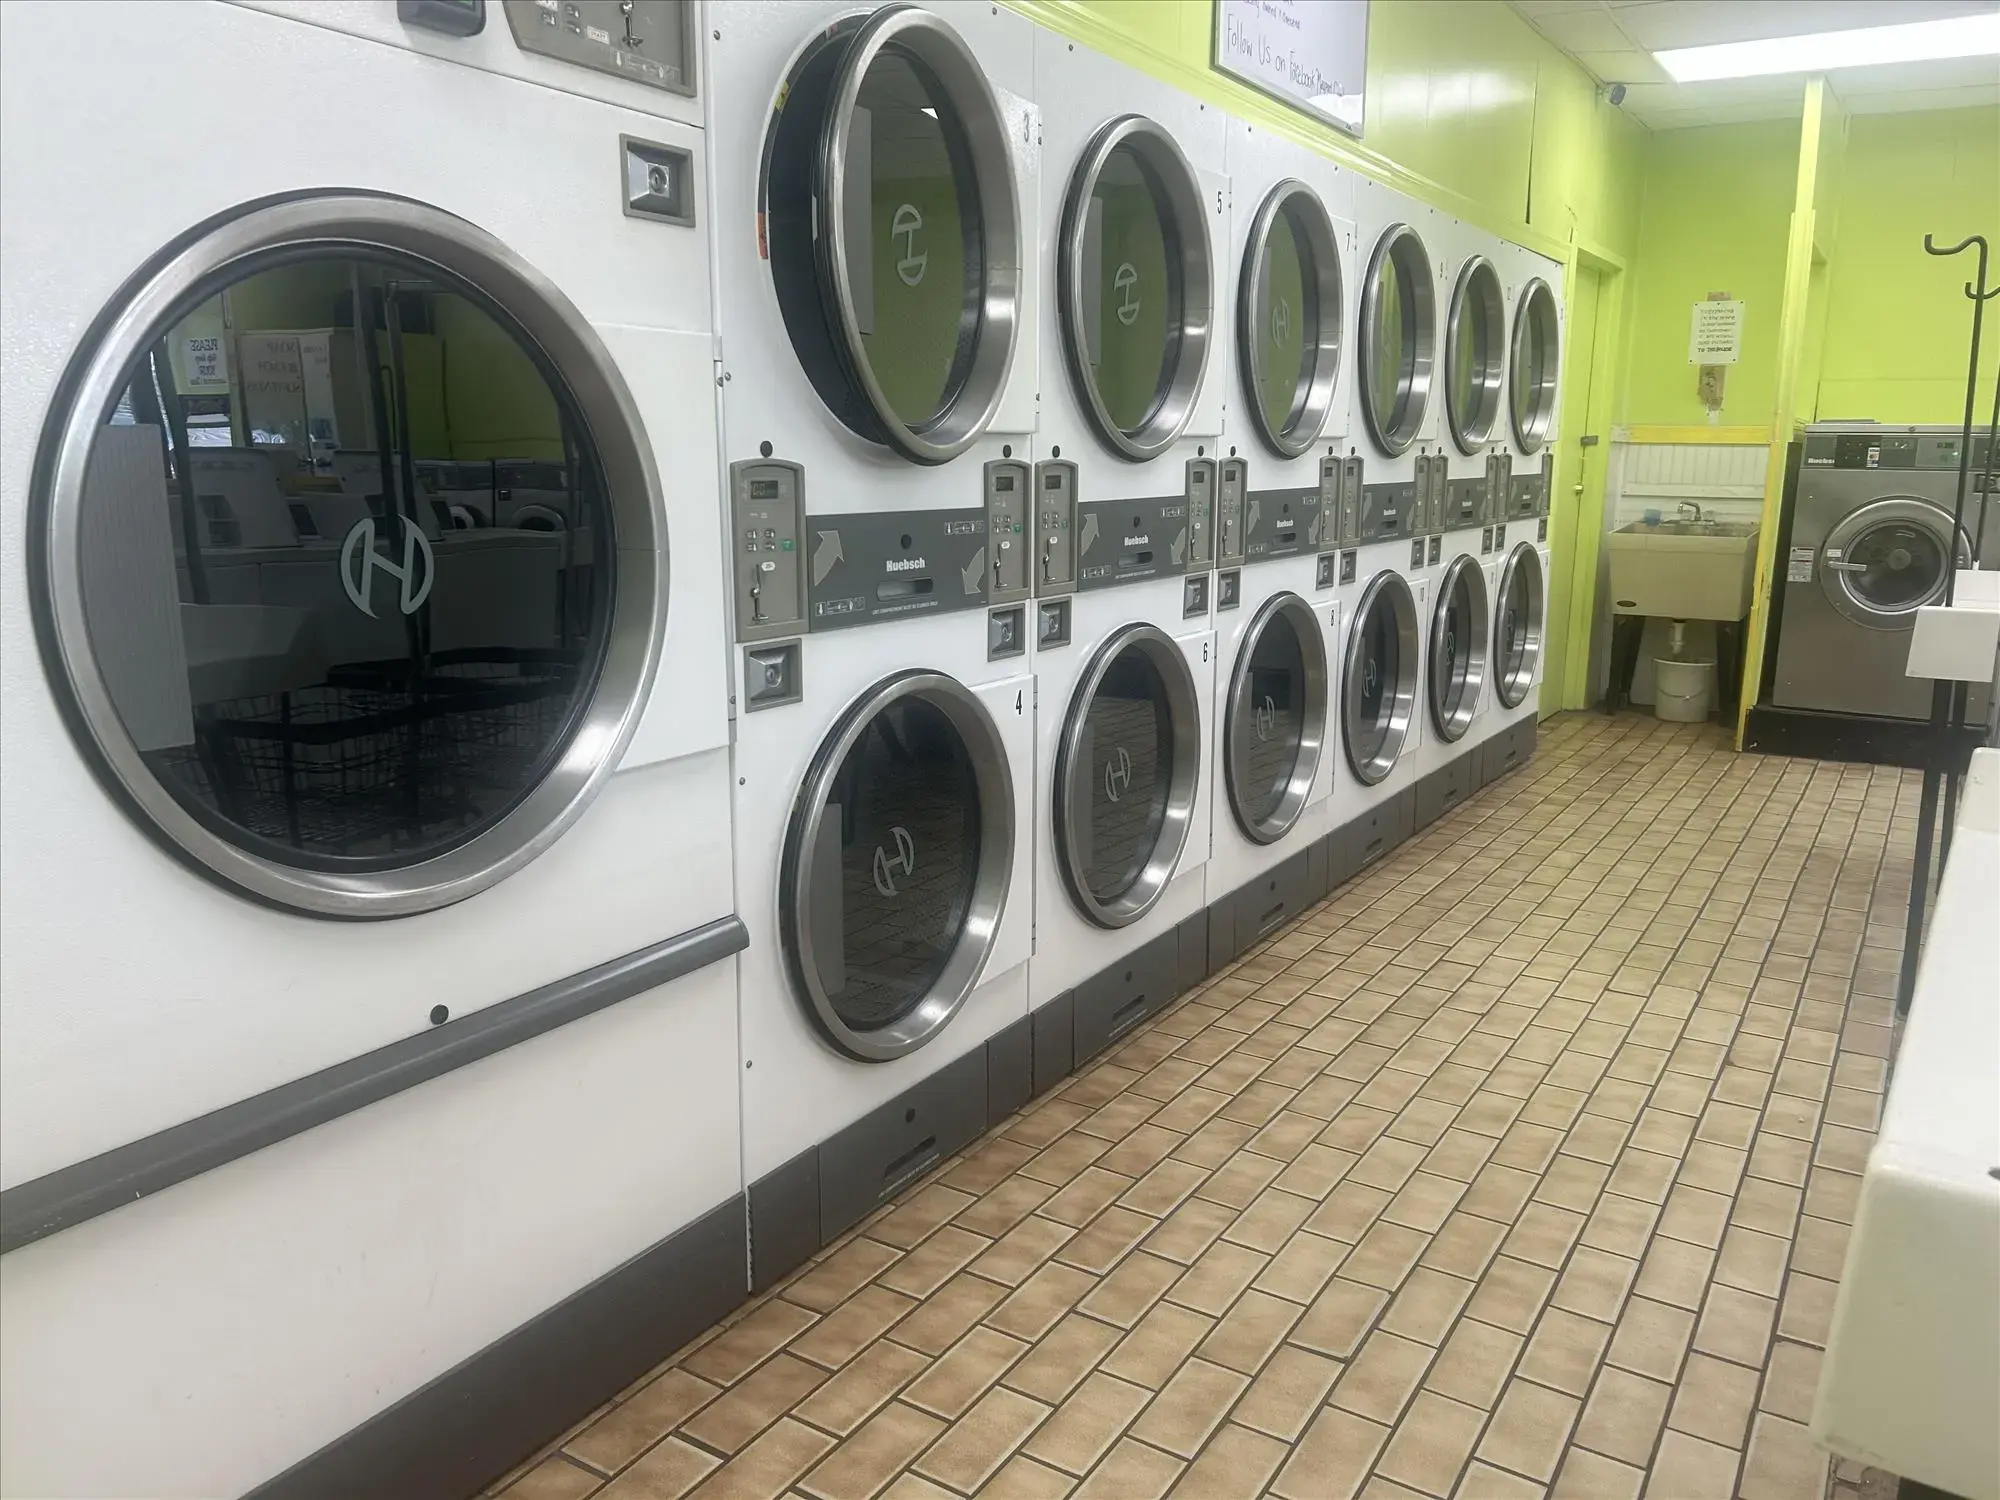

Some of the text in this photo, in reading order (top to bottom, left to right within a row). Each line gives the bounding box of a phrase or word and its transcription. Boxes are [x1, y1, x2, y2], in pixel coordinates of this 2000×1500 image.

[1228, 14, 1252, 57] Follow
[1258, 34, 1271, 65] Us
[1275, 55, 1286, 72] on
[1023, 113, 1031, 143] 3
[1216, 191, 1222, 215] 5
[886, 556, 926, 573] Huebsch
[1203, 642, 1208, 663] 6
[1015, 690, 1022, 715] 4
